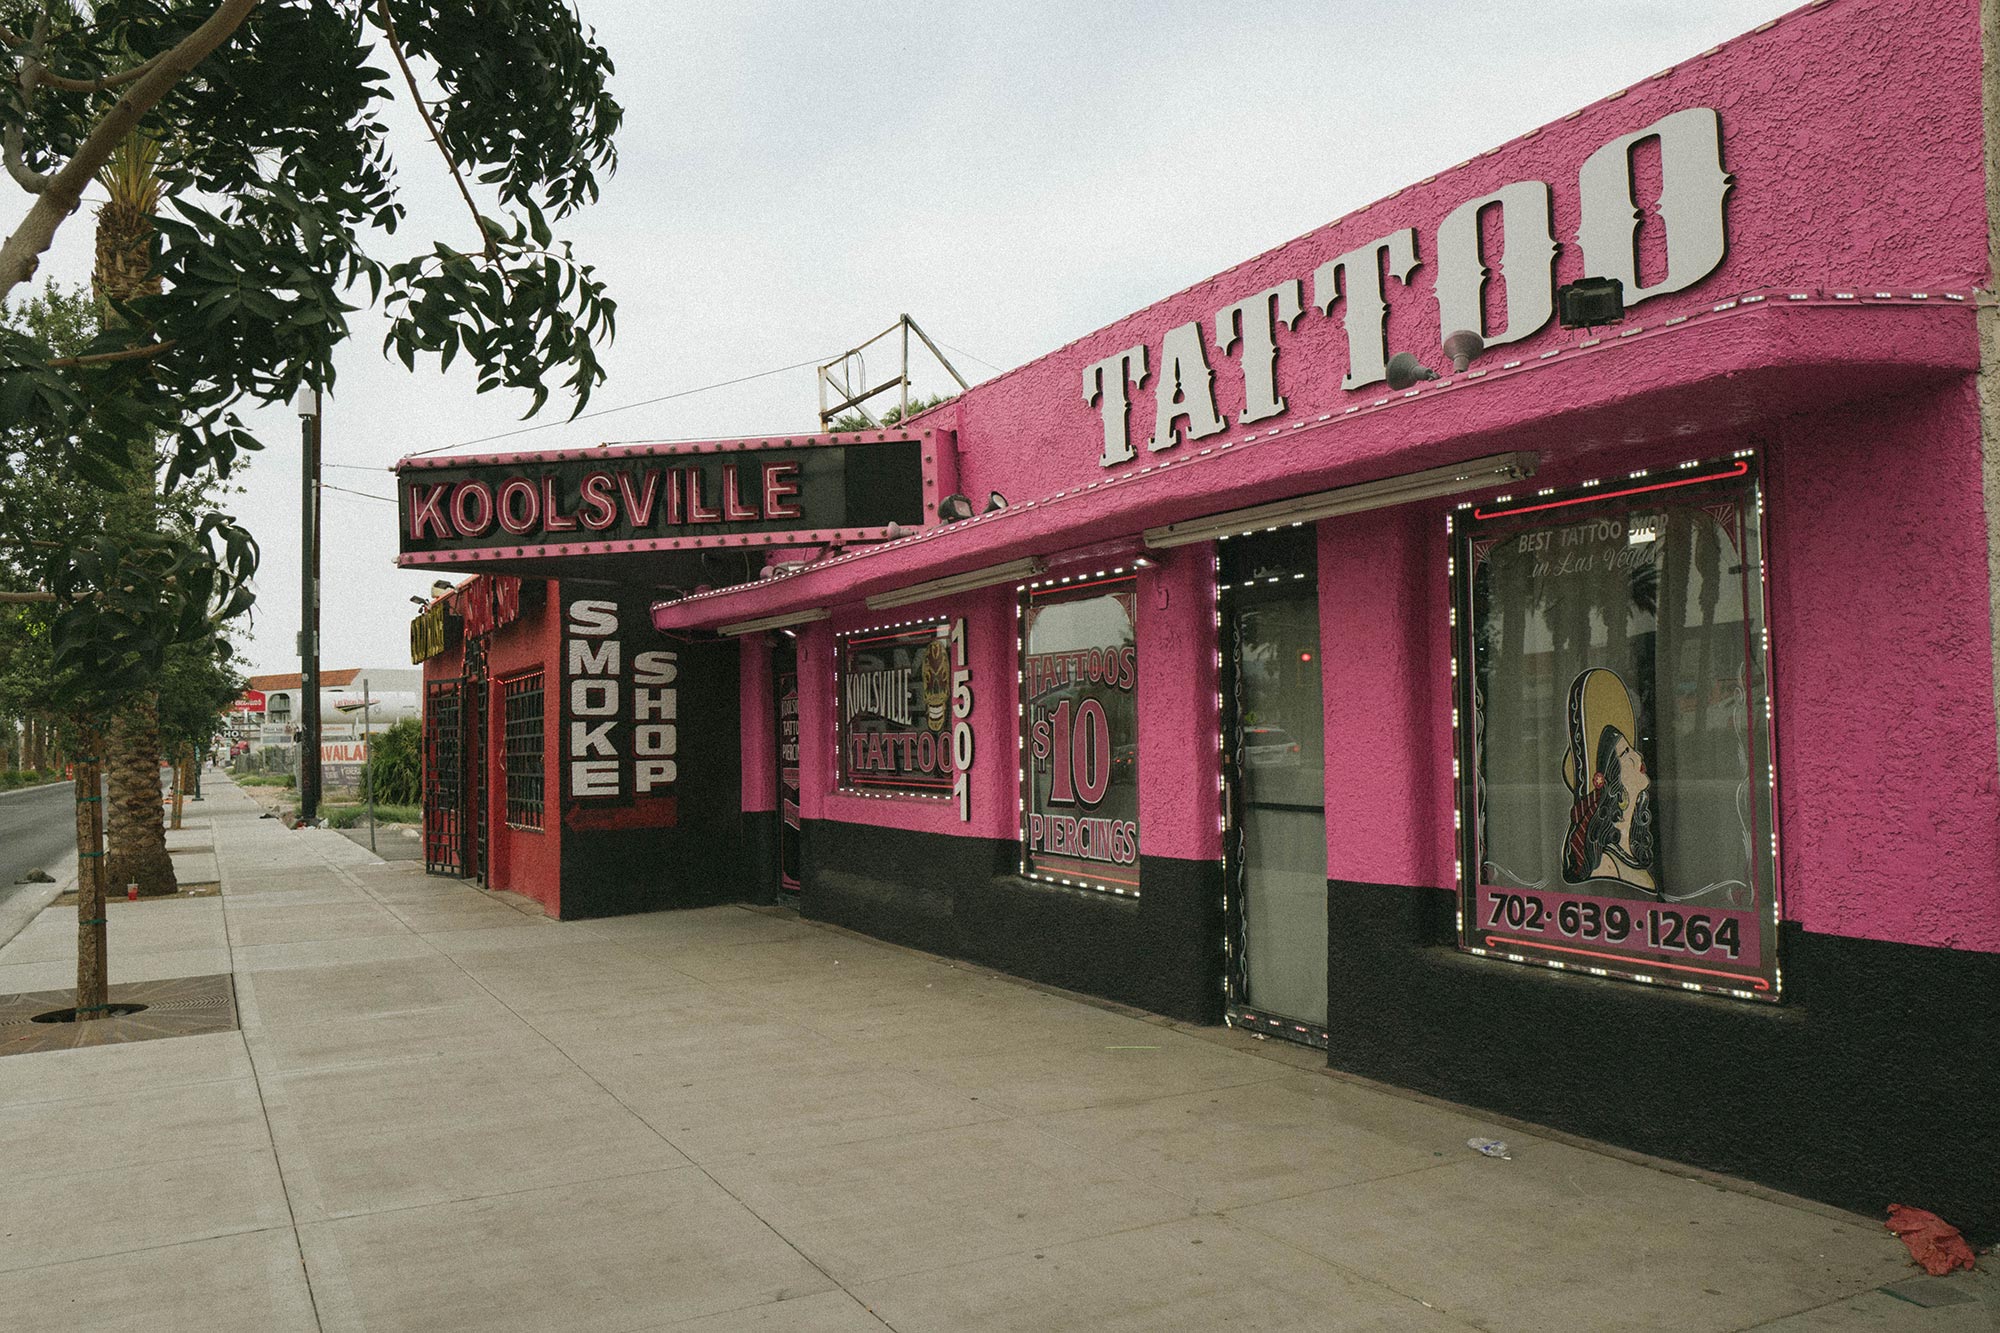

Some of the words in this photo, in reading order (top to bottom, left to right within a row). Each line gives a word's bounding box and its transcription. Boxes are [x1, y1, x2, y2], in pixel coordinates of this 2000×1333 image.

[1082, 107, 1735, 468] TATTOO
[409, 460, 799, 539] KOOLSVILLE
[1519, 531, 1551, 553] BEST
[1561, 521, 1622, 546] TATTOO
[1629, 514, 1669, 536] SHOP
[1531, 561, 1551, 578] in
[1557, 551, 1593, 575] Las
[1604, 547, 1659, 573] Vegas
[569, 600, 620, 796] SMOKE
[846, 667, 912, 726] KOOLSVILLE
[1026, 646, 1136, 700] TATTOOS
[634, 651, 678, 793] SHOP
[852, 731, 953, 773] TATTOO
[952, 618, 972, 822] 1501
[1033, 698, 1112, 806] $10
[1029, 812, 1137, 865] PIERCINGS
